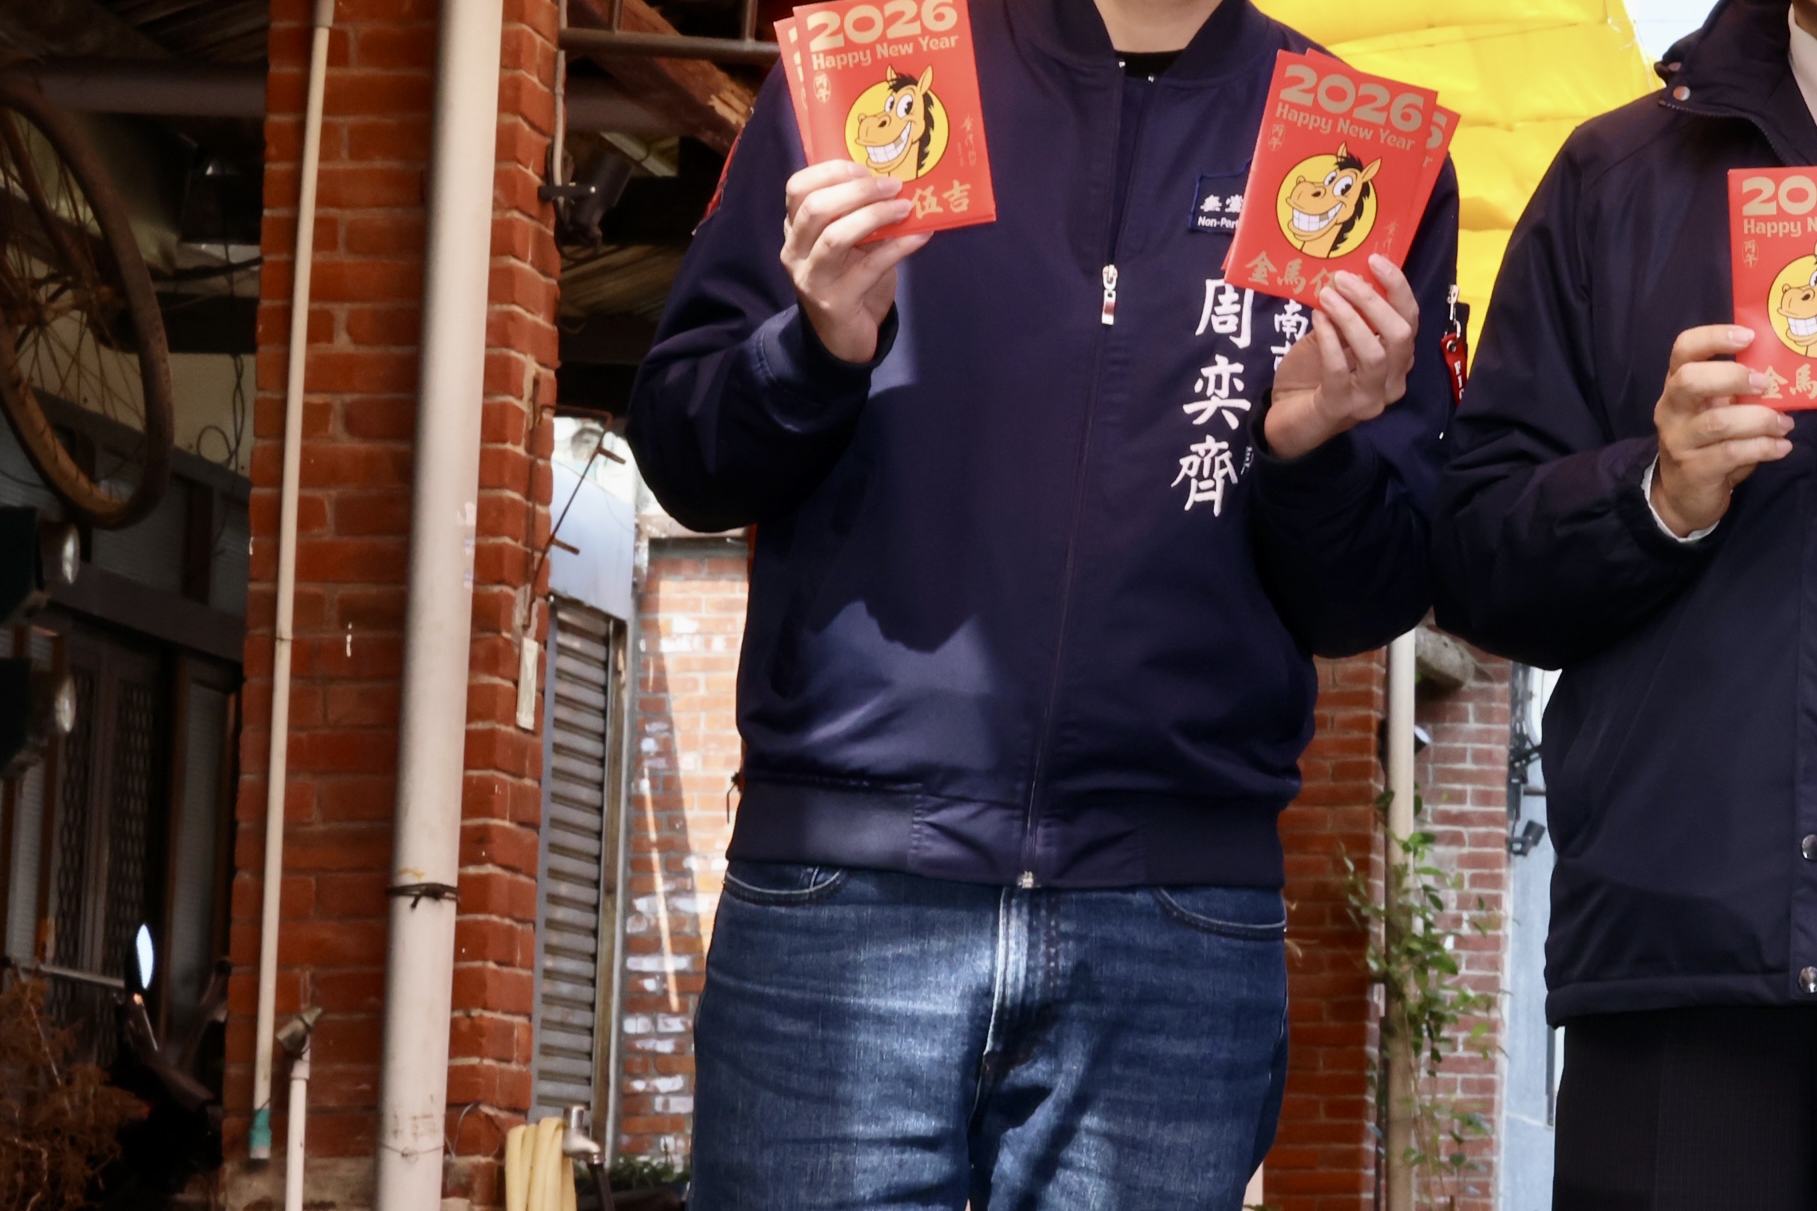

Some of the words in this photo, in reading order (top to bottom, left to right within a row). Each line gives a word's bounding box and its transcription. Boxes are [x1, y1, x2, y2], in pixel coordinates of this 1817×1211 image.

[811, 49, 872, 71] Happy
[876, 40, 914, 60] New
[919, 34, 959, 53] Year
[1279, 64, 1425, 132] 2026
[1275, 101, 1333, 134] Happy
[1336, 117, 1373, 141] New
[1378, 127, 1416, 151] Year
[910, 179, 972, 220] 伍吉
[1743, 217, 1802, 237] Happy
[1245, 250, 1373, 299] 金馬
[1171, 278, 1254, 518] 周奕齊
